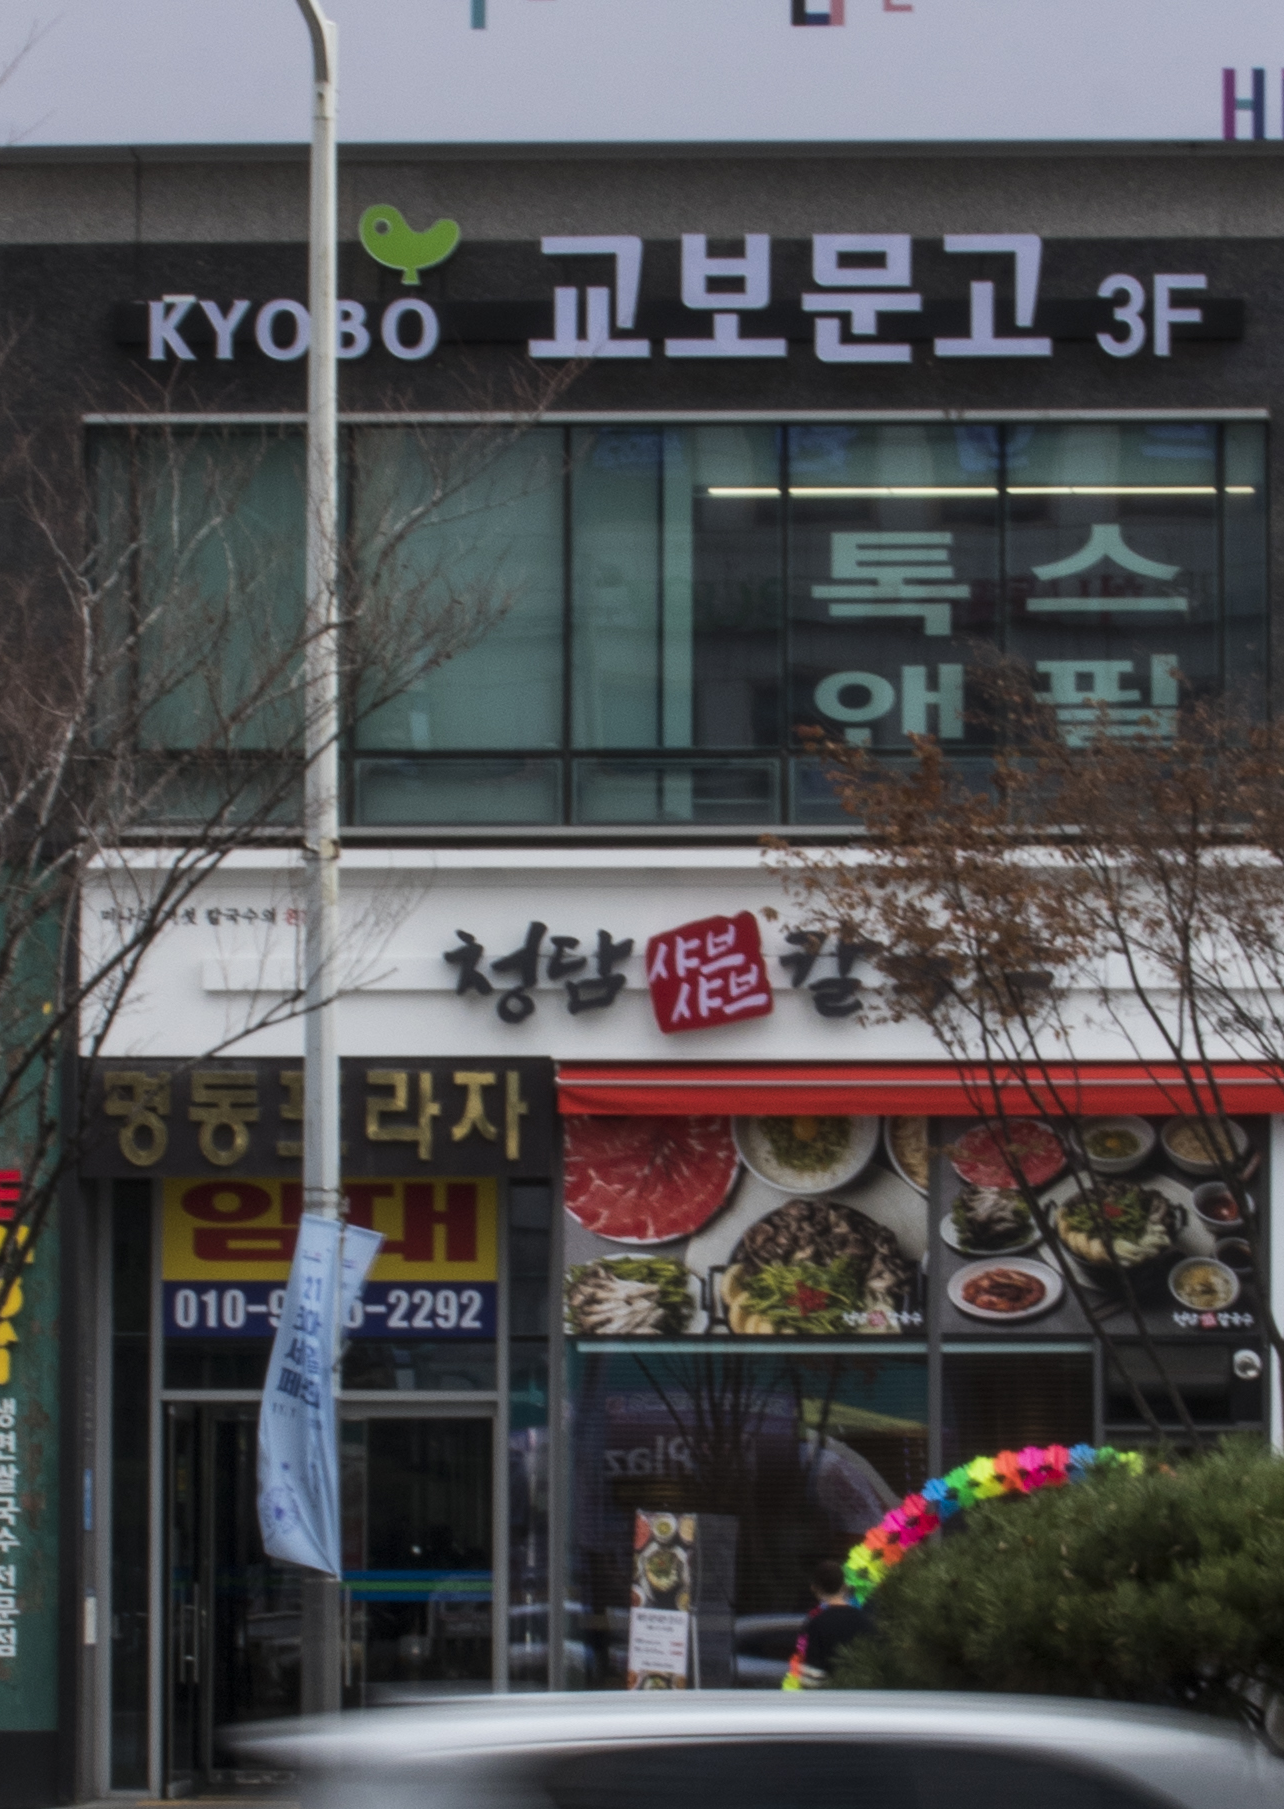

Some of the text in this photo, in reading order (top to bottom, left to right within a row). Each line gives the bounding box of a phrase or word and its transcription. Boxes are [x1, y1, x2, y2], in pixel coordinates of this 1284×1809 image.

[148, 297, 440, 362] KYOBO
[529, 234, 1207, 363] 교보문고 3F
[812, 524, 1189, 636] 톡스
[444, 921, 634, 1024] 청담
[181, 1180, 477, 1262] 임대
[174, 1288, 483, 1330] 010-95-2292
